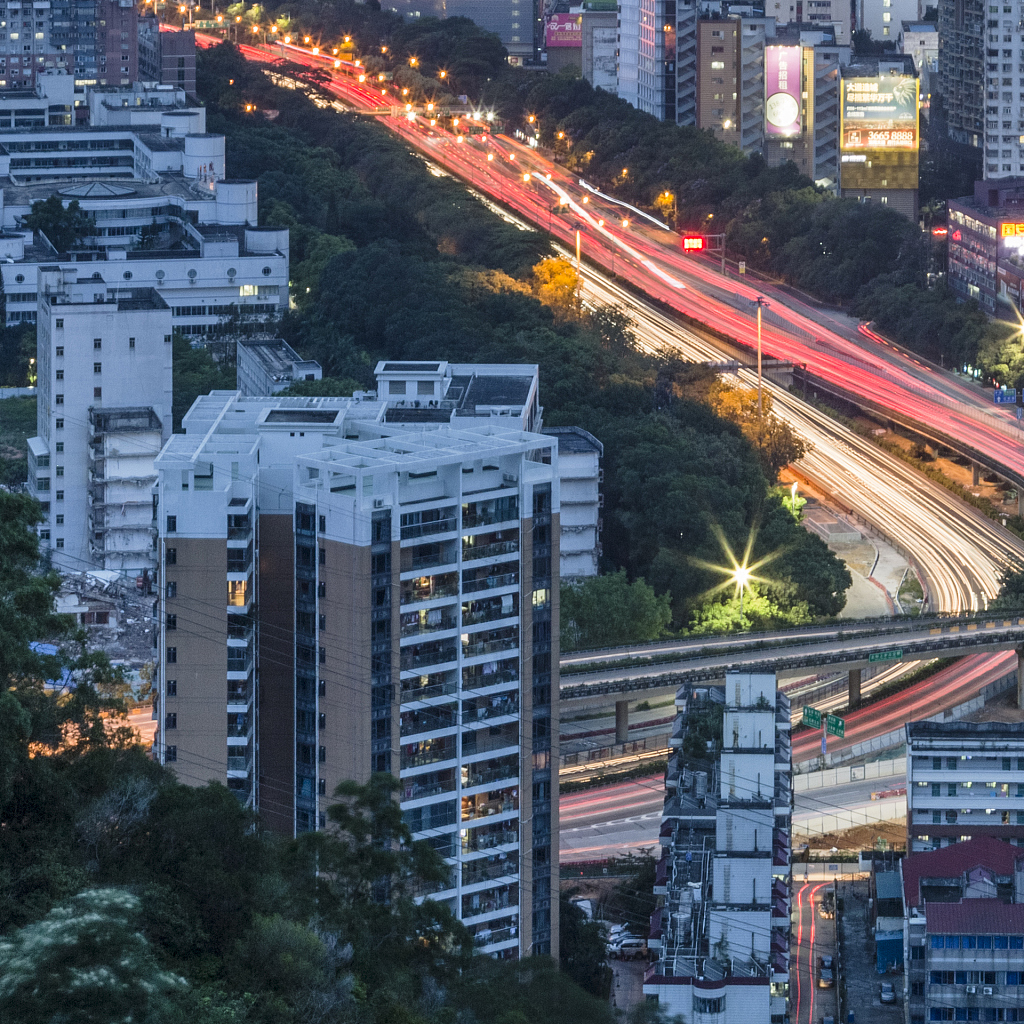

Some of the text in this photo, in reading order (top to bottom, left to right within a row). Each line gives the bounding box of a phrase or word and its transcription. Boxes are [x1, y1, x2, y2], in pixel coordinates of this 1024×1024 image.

[778, 51, 788, 90] 广告招租
[868, 131, 913, 140] 3665 8888
